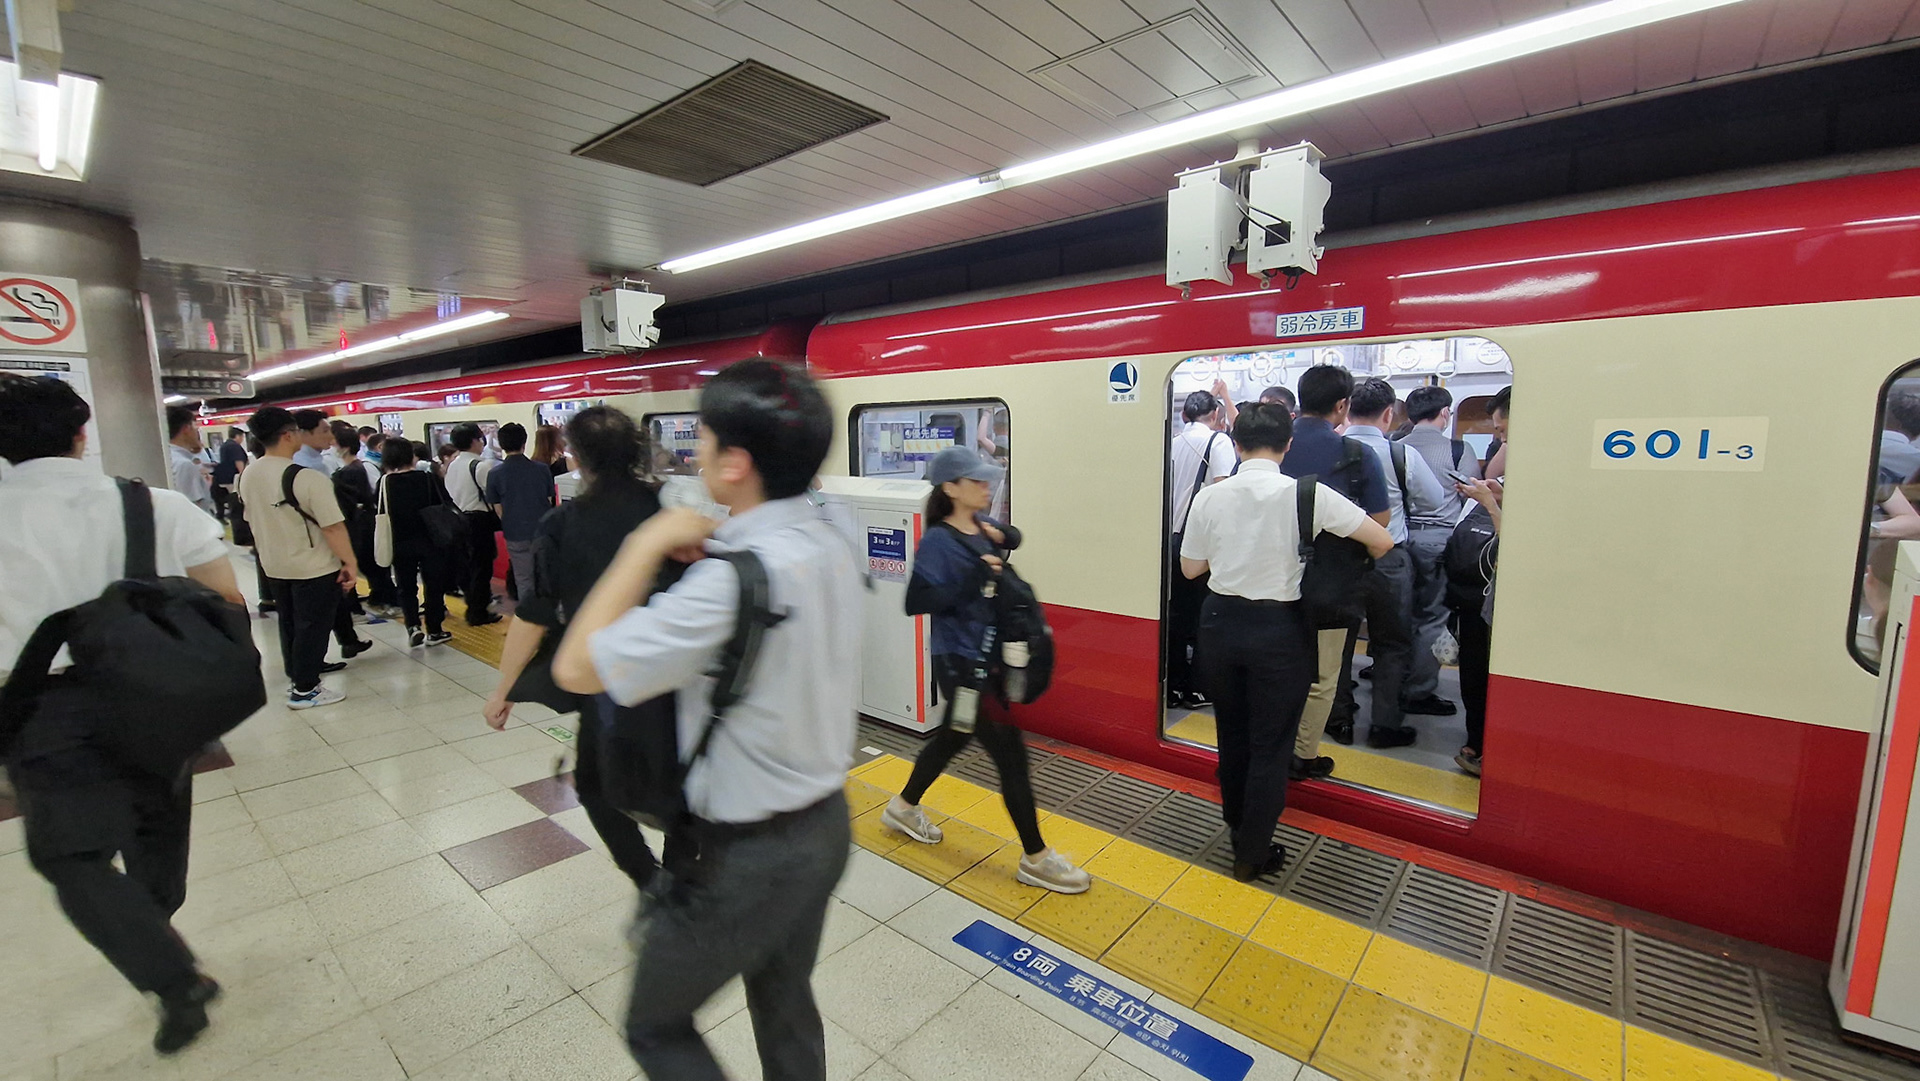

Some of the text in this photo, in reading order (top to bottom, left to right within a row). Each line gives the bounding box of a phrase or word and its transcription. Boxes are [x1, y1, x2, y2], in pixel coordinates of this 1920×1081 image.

[1280, 310, 1359, 334] 弱冷房車
[911, 428, 939, 439] 優先席
[1602, 429, 1754, 460] 601-3
[1002, 958, 1016, 970] Train
[1016, 966, 1043, 985] Boarding
[1044, 981, 1063, 994] Point
[1012, 947, 1179, 1041] 8両 乗車位置
